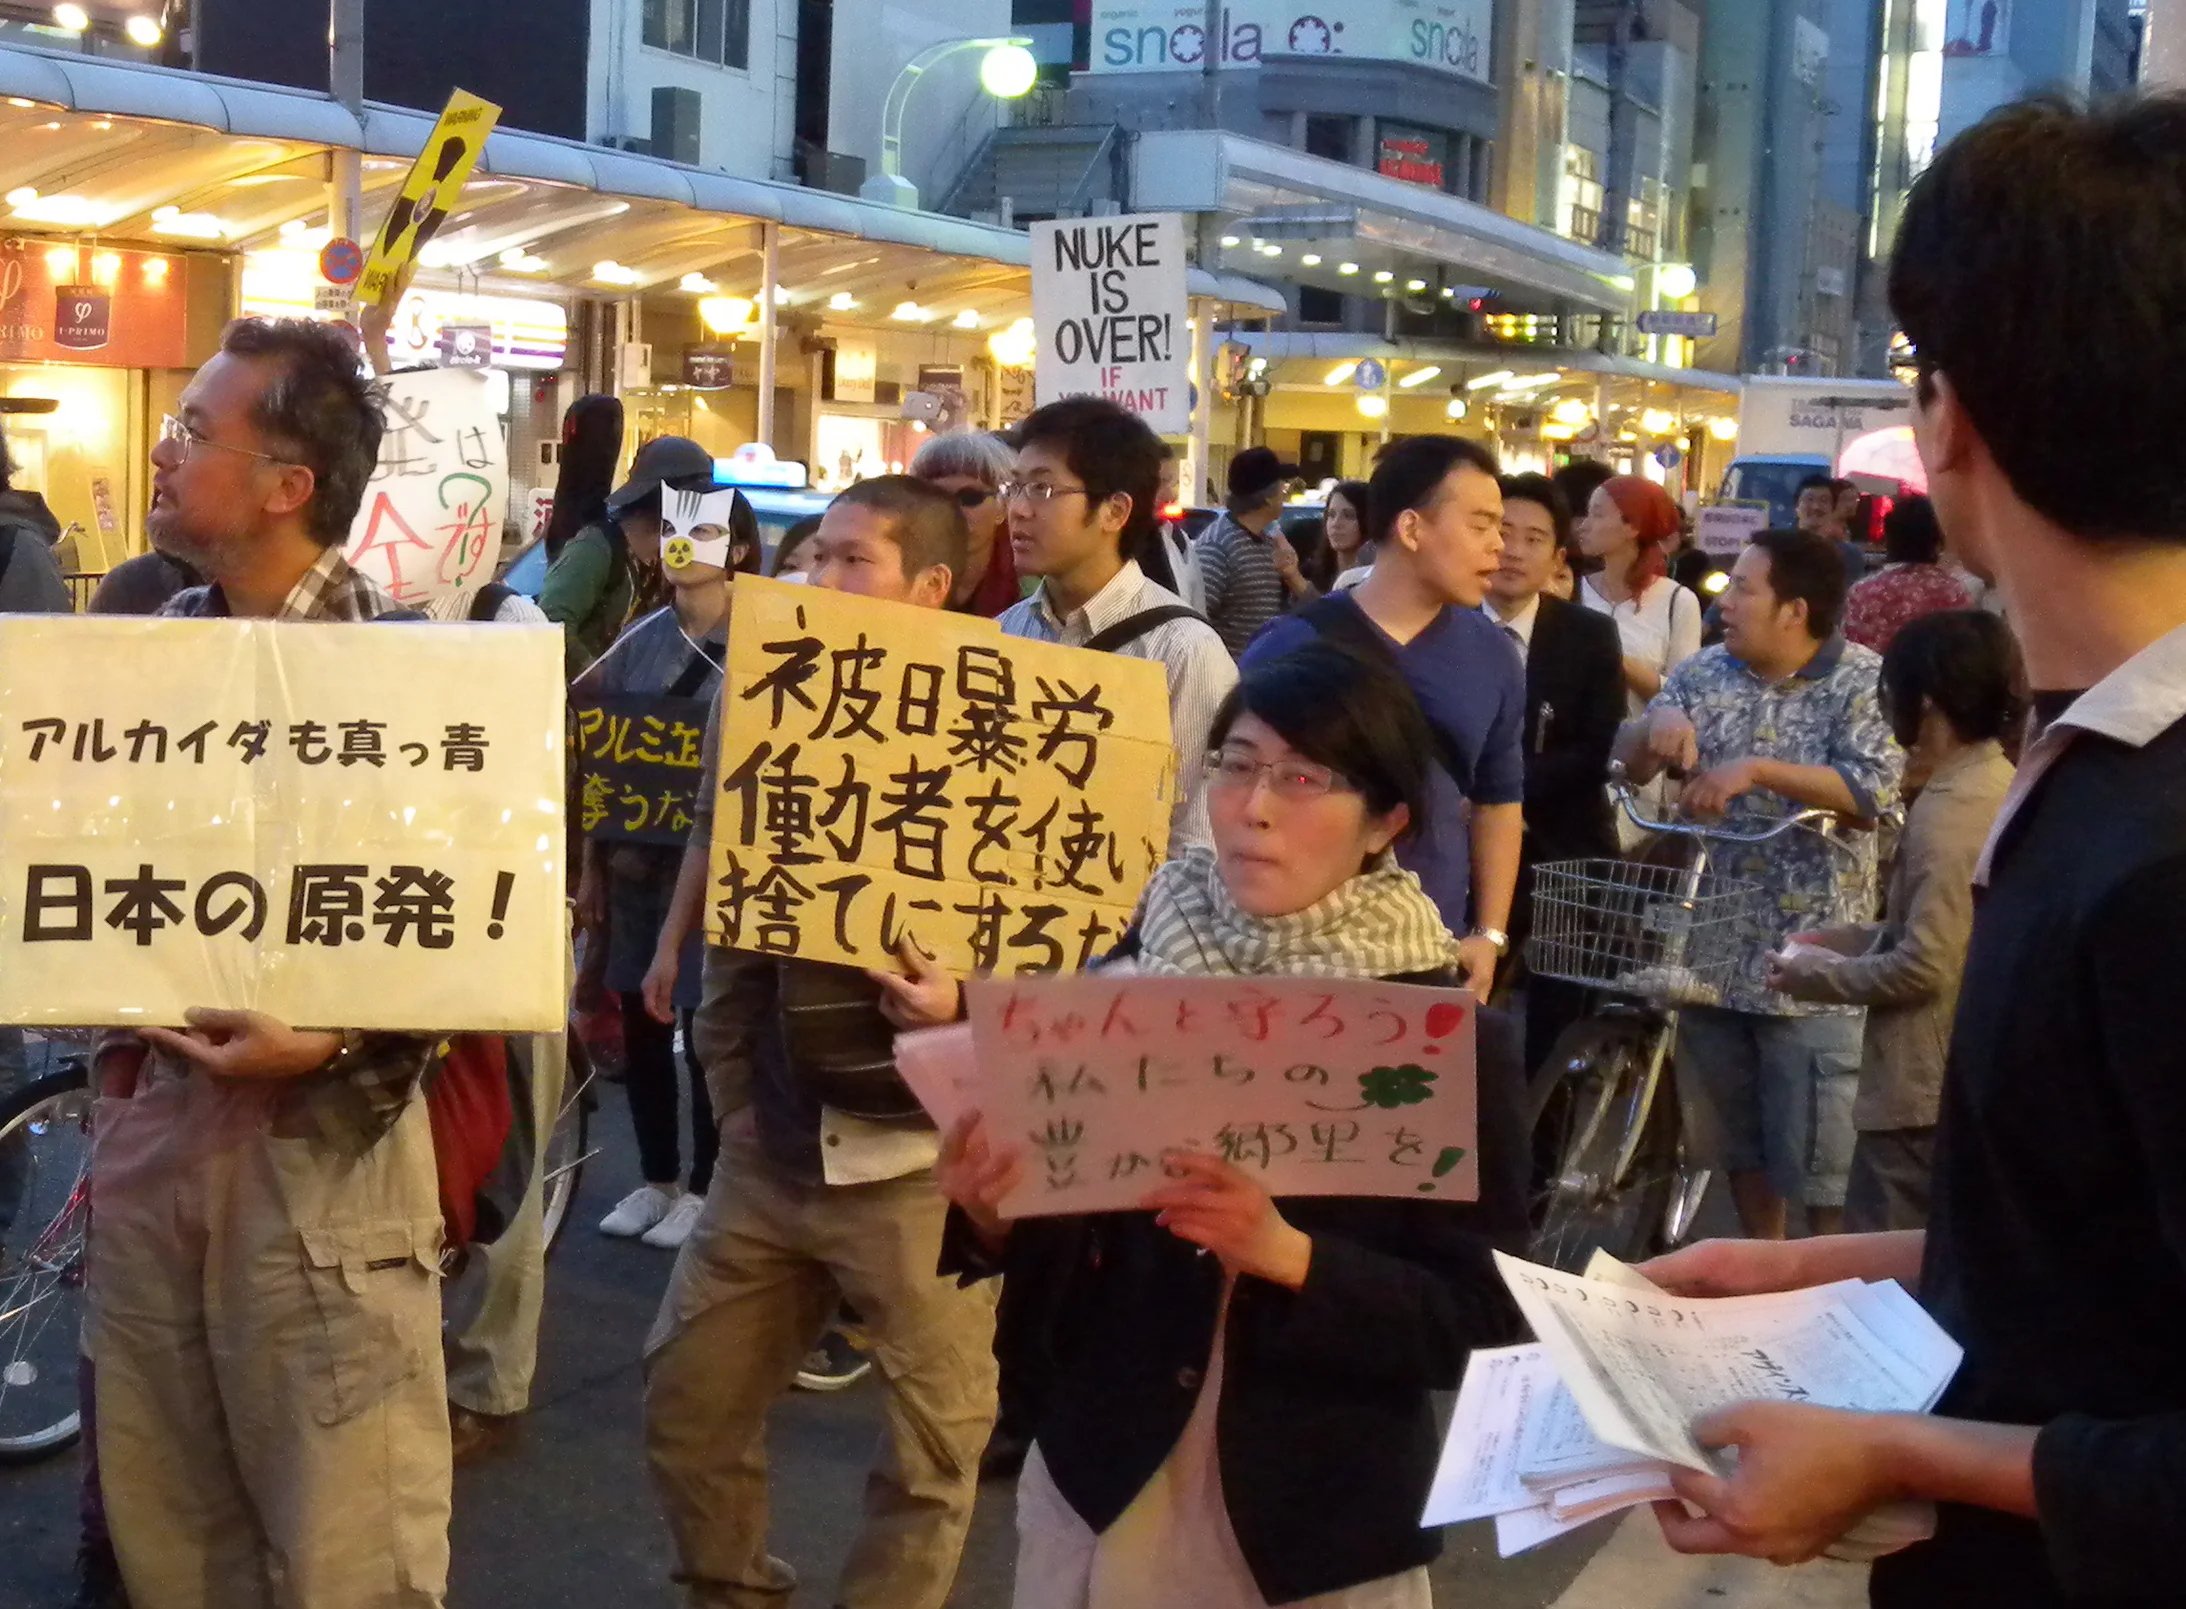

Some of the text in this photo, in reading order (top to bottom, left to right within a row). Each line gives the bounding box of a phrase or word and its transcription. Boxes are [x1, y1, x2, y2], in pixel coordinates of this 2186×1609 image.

[1104, 7, 1262, 66] snola
[1054, 222, 1160, 272] NUKE
[1090, 269, 1129, 315] IS
[1055, 313, 1172, 364] OVER!
[1101, 366, 1122, 388] IF
[742, 604, 1114, 790] 被曝労
[22, 718, 490, 772] アルカイダも真っ青
[22, 863, 516, 950] 日本の原発！
[1028, 1053, 1330, 1102] 私たちの
